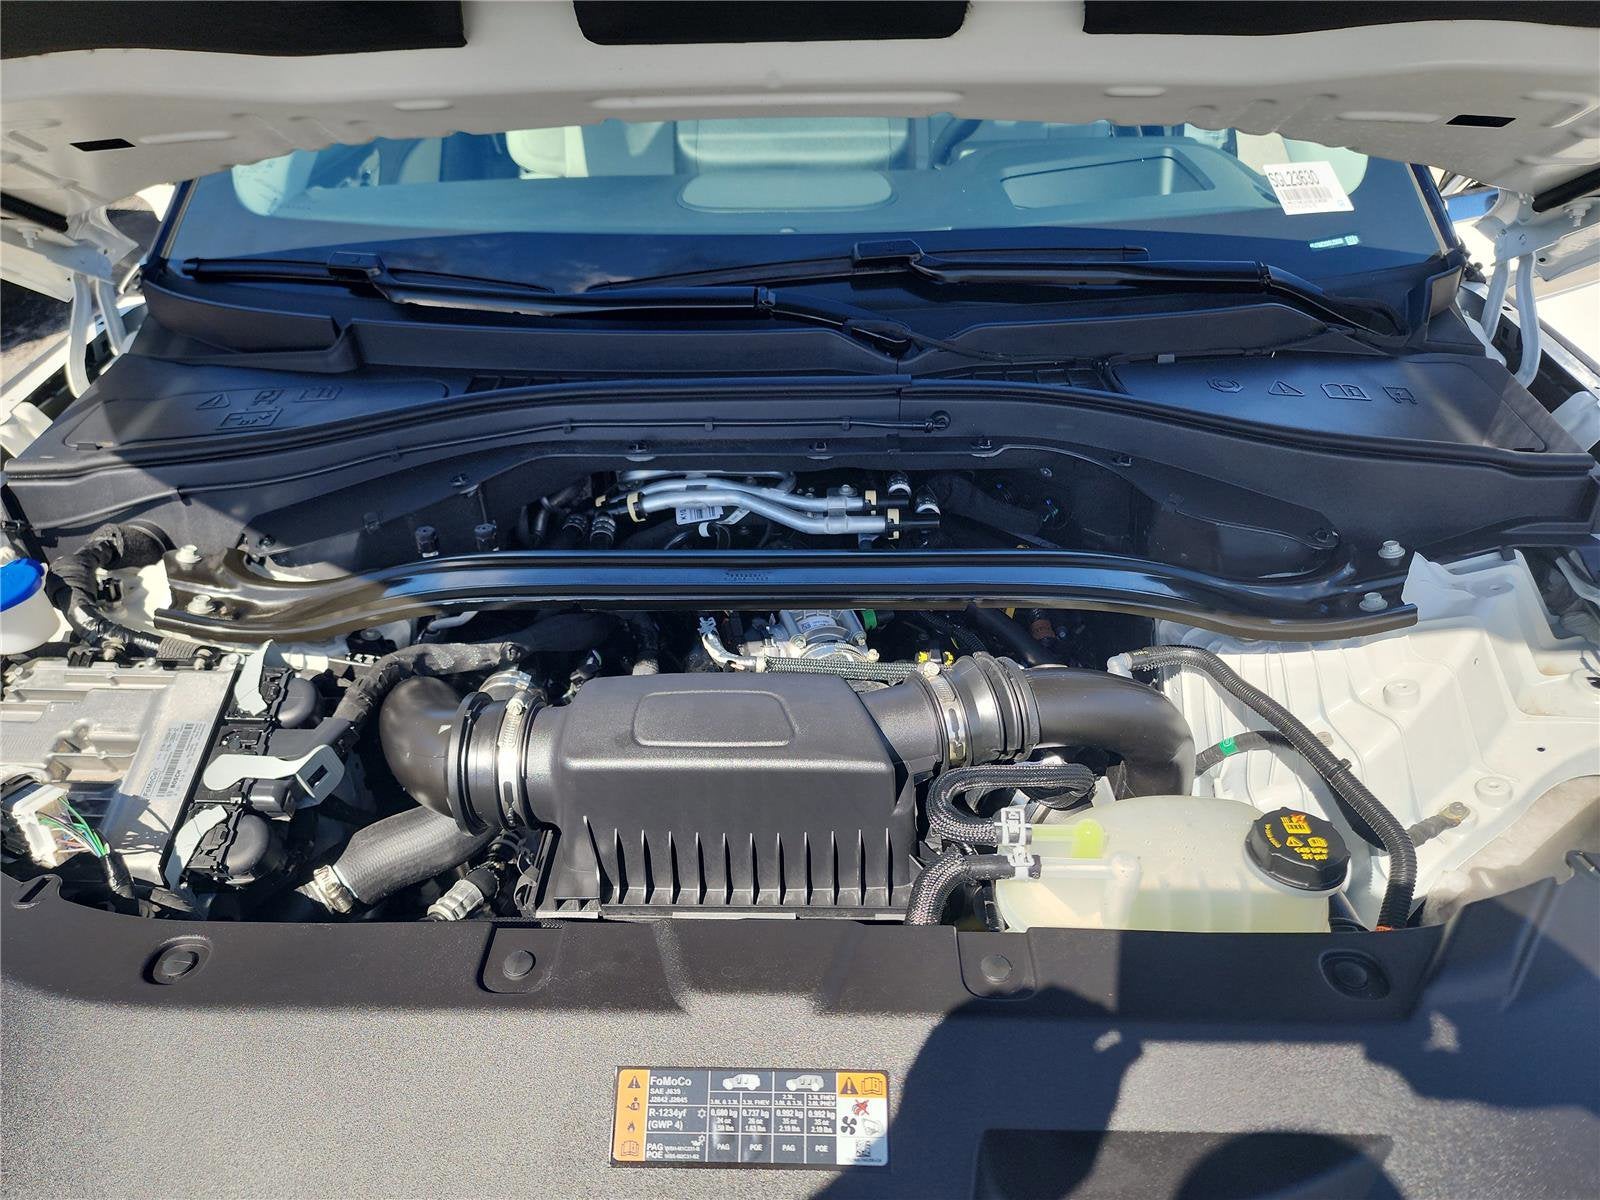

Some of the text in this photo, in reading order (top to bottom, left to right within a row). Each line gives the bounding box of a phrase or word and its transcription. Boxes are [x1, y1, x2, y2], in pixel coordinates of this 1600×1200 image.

[650, 1076, 692, 1086] FoMoCo
[649, 1108, 687, 1119] R-1234yf
[729, 1108, 738, 1119] kg
[742, 1109, 770, 1119] 0.737 kg
[794, 1109, 804, 1119] kg
[826, 1110, 836, 1120] kg
[648, 1120, 684, 1131] (GWP 4)
[646, 1143, 664, 1151] PAG
[646, 1151, 664, 1159] POE
